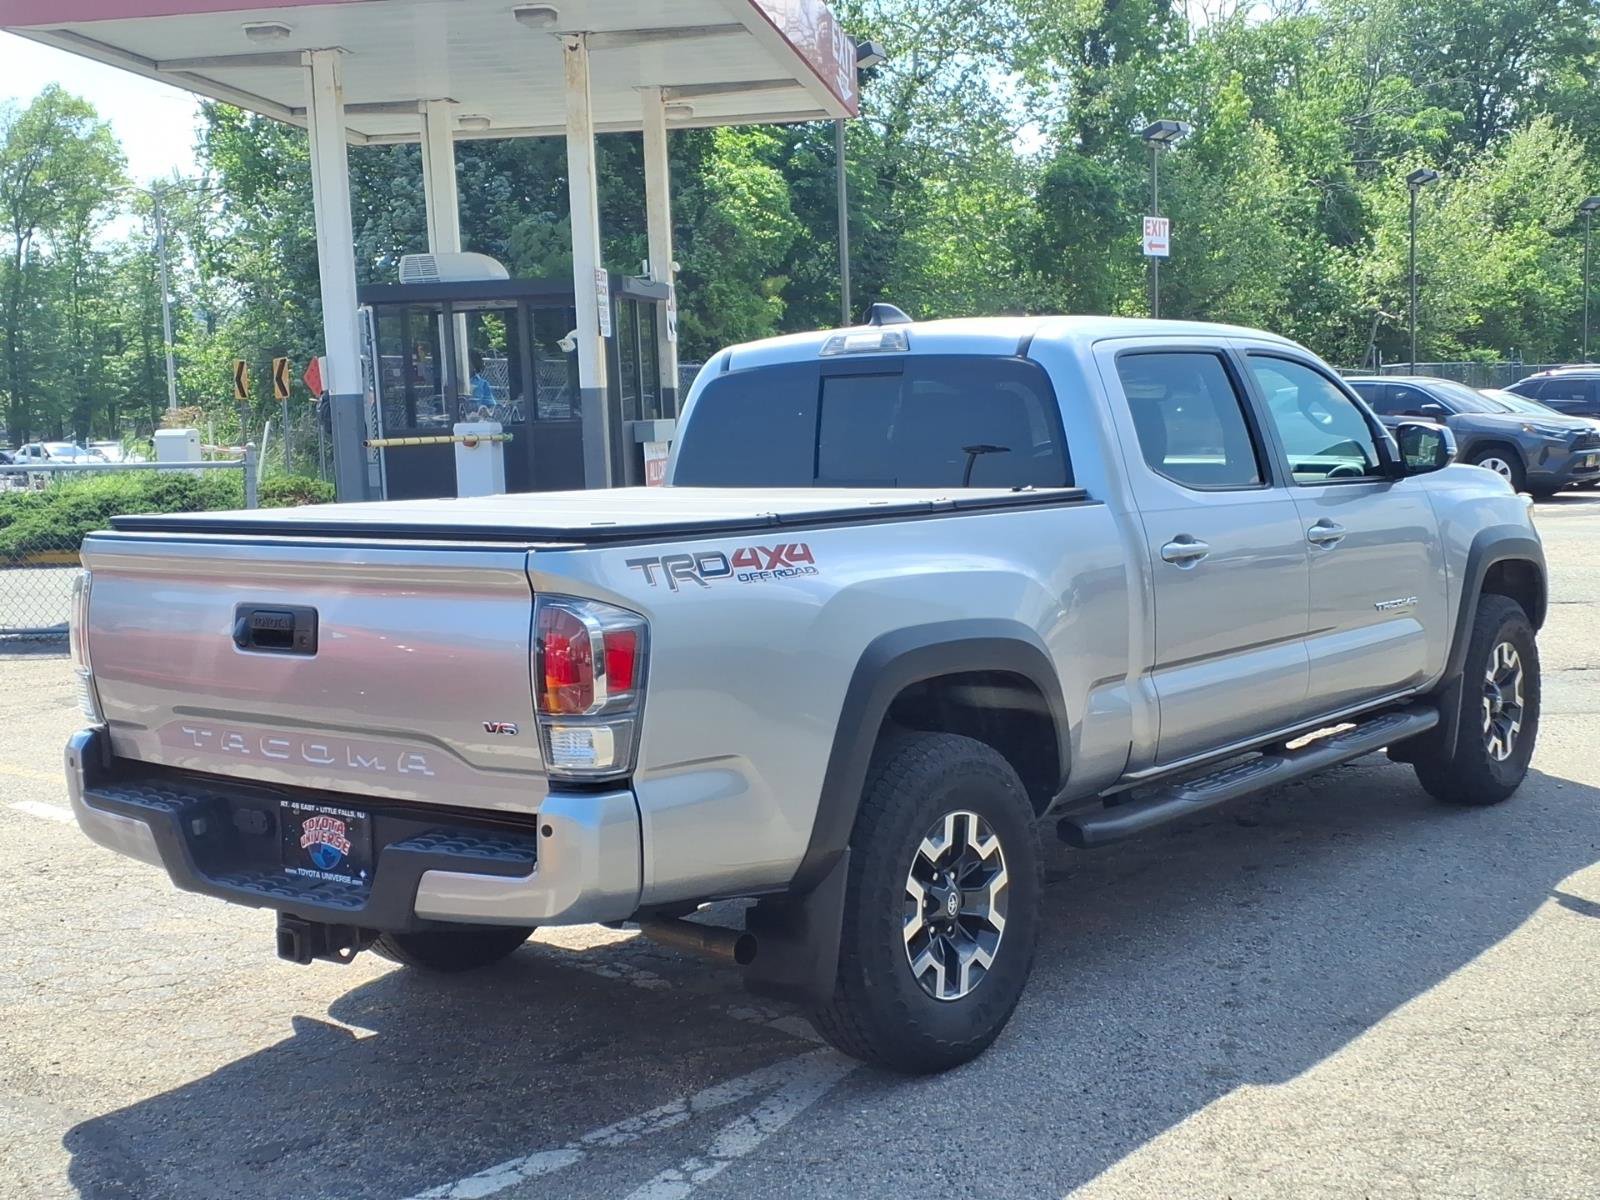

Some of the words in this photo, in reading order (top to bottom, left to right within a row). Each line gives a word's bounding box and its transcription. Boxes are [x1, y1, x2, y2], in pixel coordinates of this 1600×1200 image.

[1145, 219, 1168, 237] EXIT
[625, 550, 735, 592] TRD
[737, 570, 772, 584] OFF
[771, 565, 820, 580] ROAD
[482, 721, 519, 736] V6
[182, 725, 436, 776] TACOMA
[300, 804, 315, 812] EAST
[320, 806, 338, 815] LITTLE
[302, 815, 345, 837] TOYOTA
[300, 830, 351, 856] UNIVERSE
